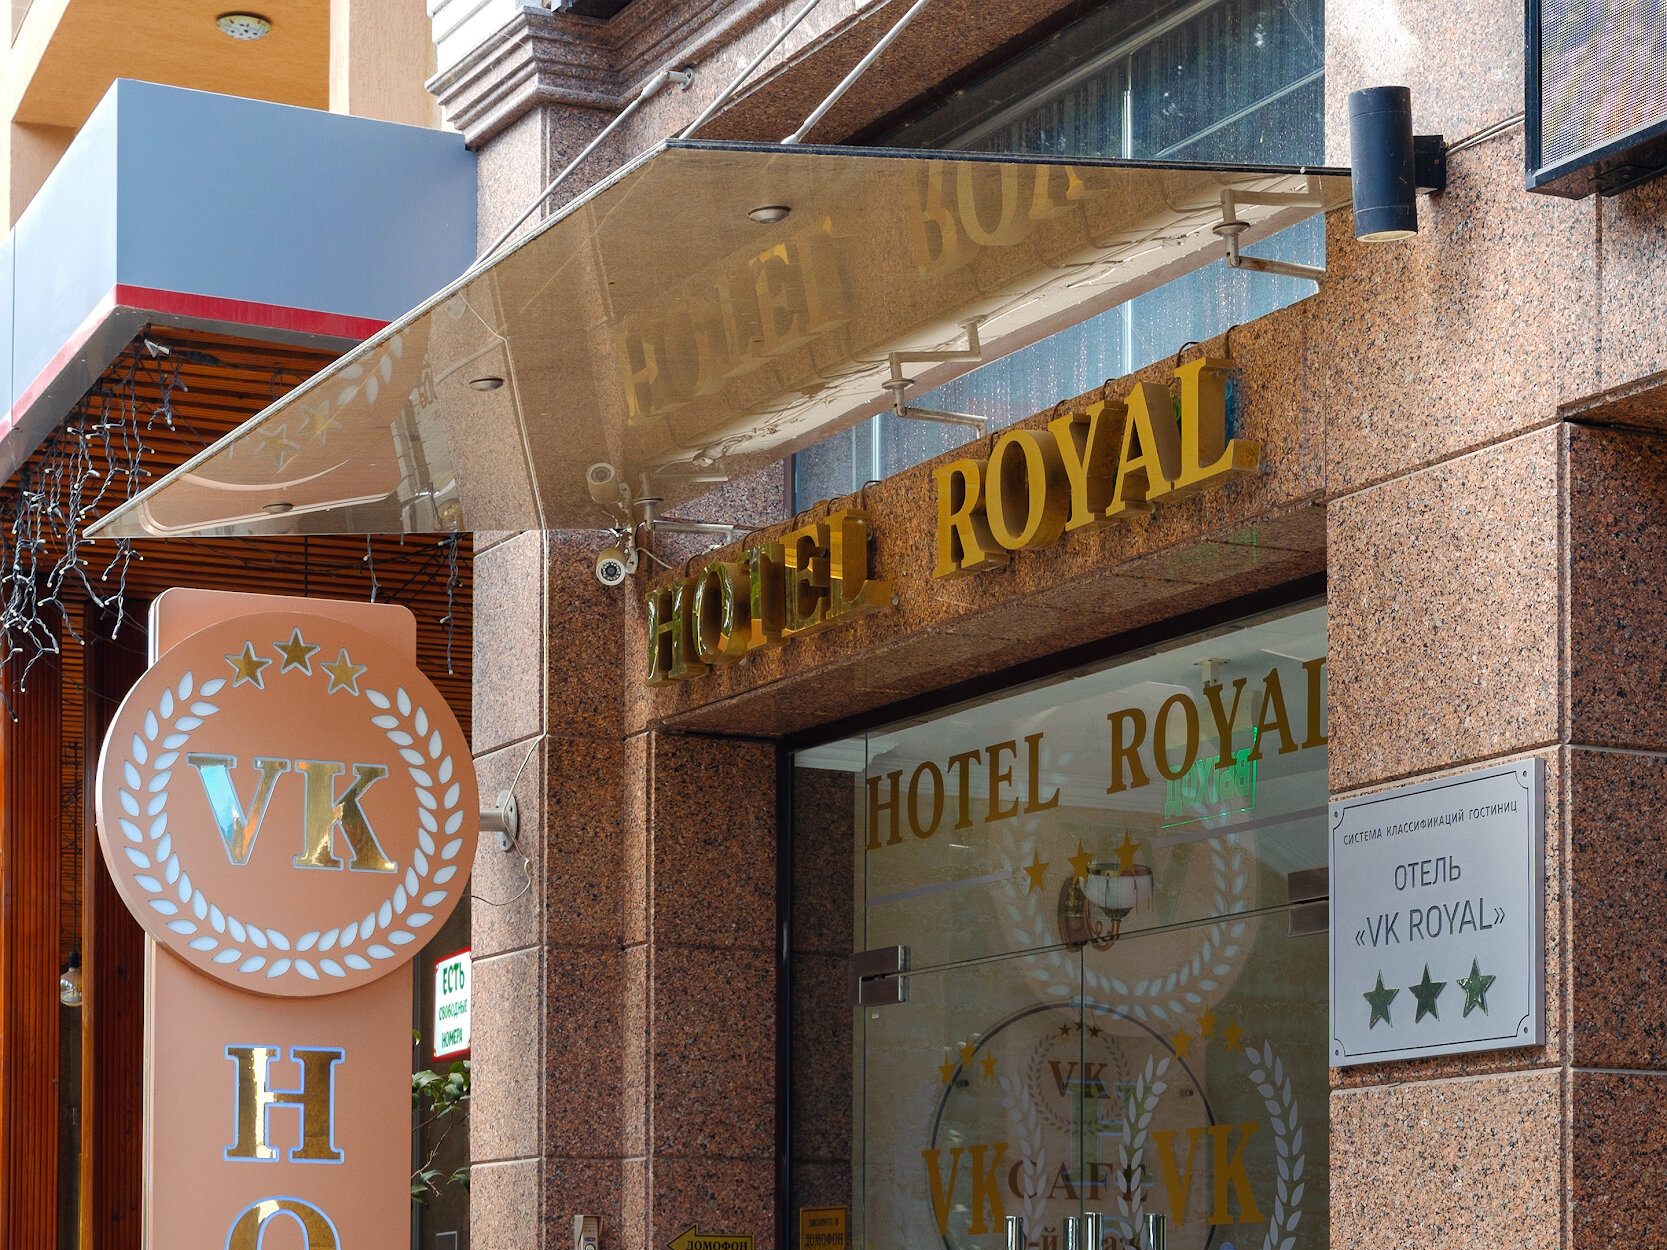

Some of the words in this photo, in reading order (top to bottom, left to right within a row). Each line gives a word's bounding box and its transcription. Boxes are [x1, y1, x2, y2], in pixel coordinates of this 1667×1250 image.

[646, 508, 892, 687] HOTEL
[932, 356, 1262, 580] ROYAL
[866, 732, 1060, 851] HOTEL
[1106, 656, 1328, 795] ROYAL
[186, 752, 398, 874] VK
[1343, 827, 1383, 846] СИСТЕМА
[1386, 809, 1465, 837] КЛАССИФИКАЦИЙ
[1468, 800, 1518, 821] ГОСТИНИЦ
[1394, 855, 1462, 891] ОТЕЛЬ
[1354, 911, 1401, 948] «VK
[1408, 897, 1506, 942] ROYAL»
[442, 961, 465, 996] ЕСТЬ
[438, 998, 468, 1021] СВОБОДНЫЕ
[441, 1027, 463, 1049] НОМЕРА
[1048, 1060, 1111, 1099] VK
[921, 1142, 1009, 1237] VK
[1007, 1160, 1149, 1201] CAFE
[1152, 1121, 1265, 1228] VK
[804, 1232, 844, 1249] ДОМОФОН
